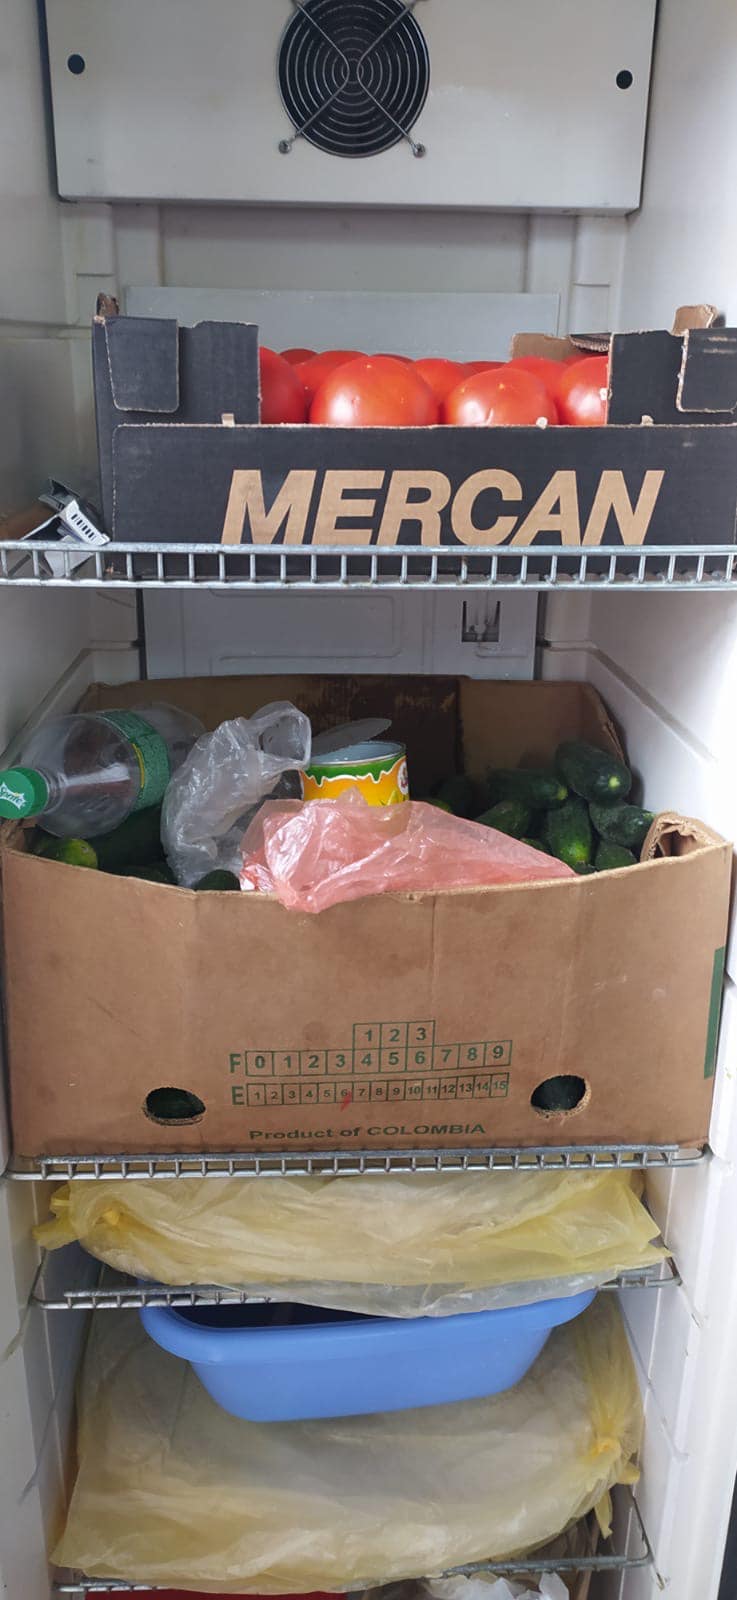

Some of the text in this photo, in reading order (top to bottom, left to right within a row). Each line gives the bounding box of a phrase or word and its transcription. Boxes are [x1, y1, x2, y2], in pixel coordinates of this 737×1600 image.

[220, 469, 665, 547] MERCAN
[364, 1027, 427, 1042] 1 2 3
[229, 1053, 241, 1073] F
[283, 1055, 292, 1069] 1
[308, 1054, 320, 1069] 2
[335, 1054, 346, 1068] 3
[361, 1053, 372, 1067] 4
[388, 1051, 399, 1066] 5
[414, 1050, 426, 1065] 6
[441, 1048, 452, 1063] 7
[467, 1046, 478, 1061] 8
[492, 1045, 504, 1060] 9
[231, 1085, 245, 1106] E
[271, 1090, 279, 1100] 2
[287, 1089, 297, 1100] 3
[305, 1089, 315, 1099] 4
[323, 1088, 332, 1098] 5
[358, 1087, 367, 1097] 7
[375, 1086, 384, 1096] 8
[392, 1086, 402, 1096] 9
[407, 1085, 422, 1095] 10
[426, 1084, 438, 1095] 11
[442, 1083, 457, 1095] 12
[459, 1082, 473, 1093] 13
[475, 1081, 490, 1092] 14
[493, 1080, 507, 1091] 15
[249, 1123, 486, 1140] Product of COLOMBIA
